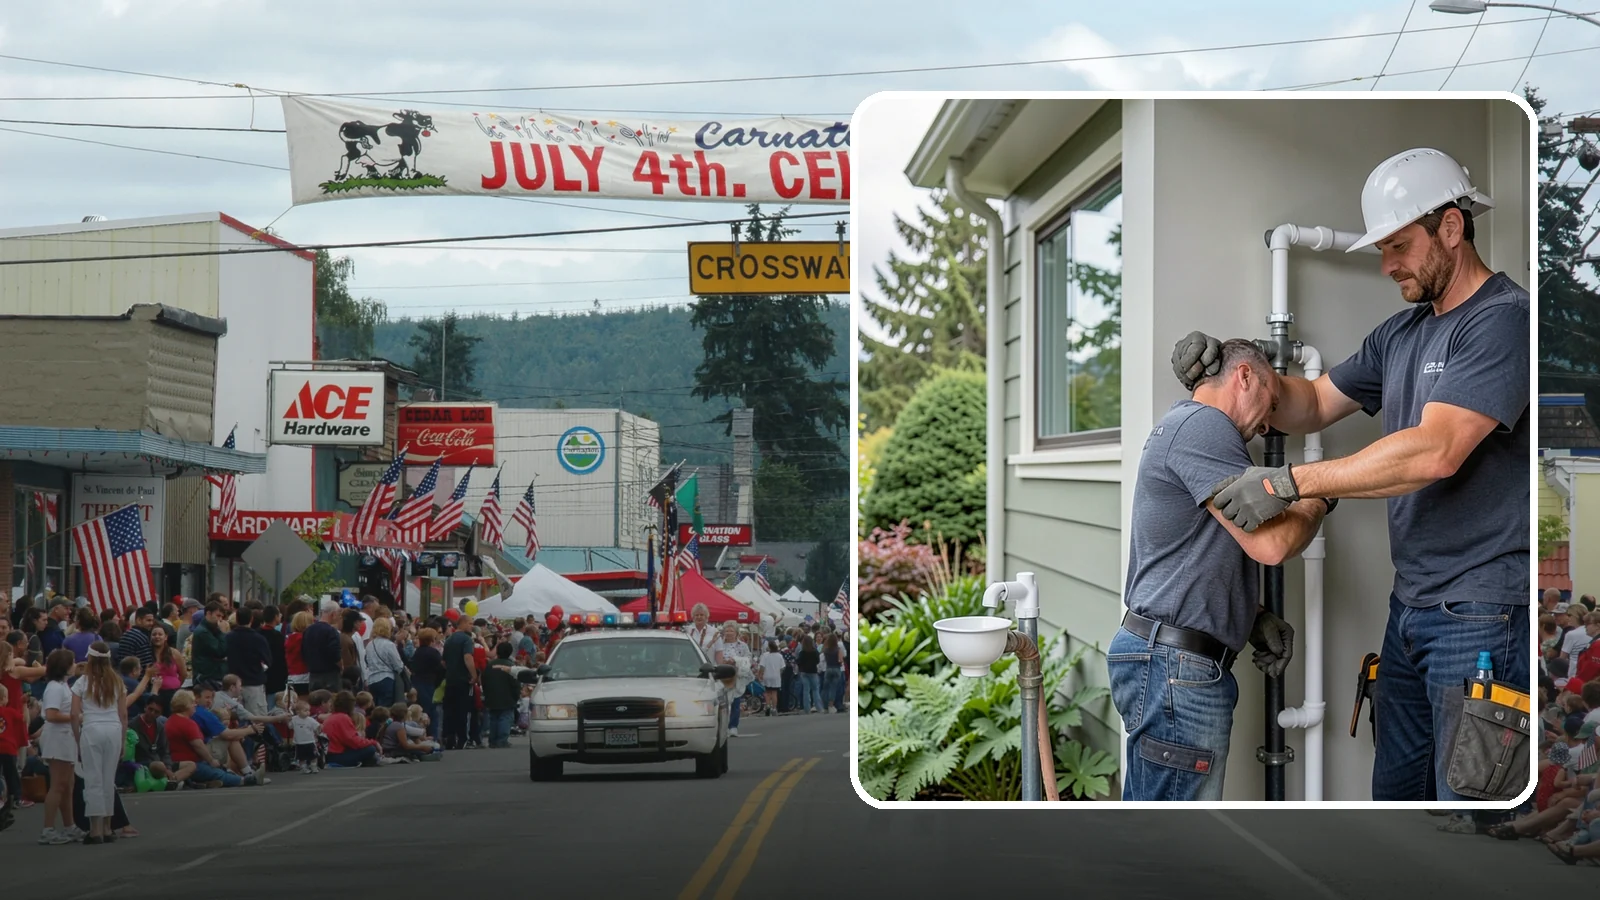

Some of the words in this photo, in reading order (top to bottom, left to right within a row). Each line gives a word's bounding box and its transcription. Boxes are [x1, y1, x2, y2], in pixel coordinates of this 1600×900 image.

[481, 141, 604, 192] JULY
[632, 149, 746, 198] 4th.
[697, 254, 850, 279] CROSSWA
[282, 380, 373, 419] ACE
[405, 409, 453, 422] CEDAR
[283, 421, 371, 436] Hardware
[416, 428, 477, 447] Coca-Cola
[353, 467, 384, 480] Simpl
[95, 485, 124, 495] Vincent
[126, 486, 135, 495] de
[137, 486, 155, 495] Paul
[81, 502, 154, 522] THT
[687, 526, 741, 535] CRNATION
[699, 535, 730, 543] GLASS
